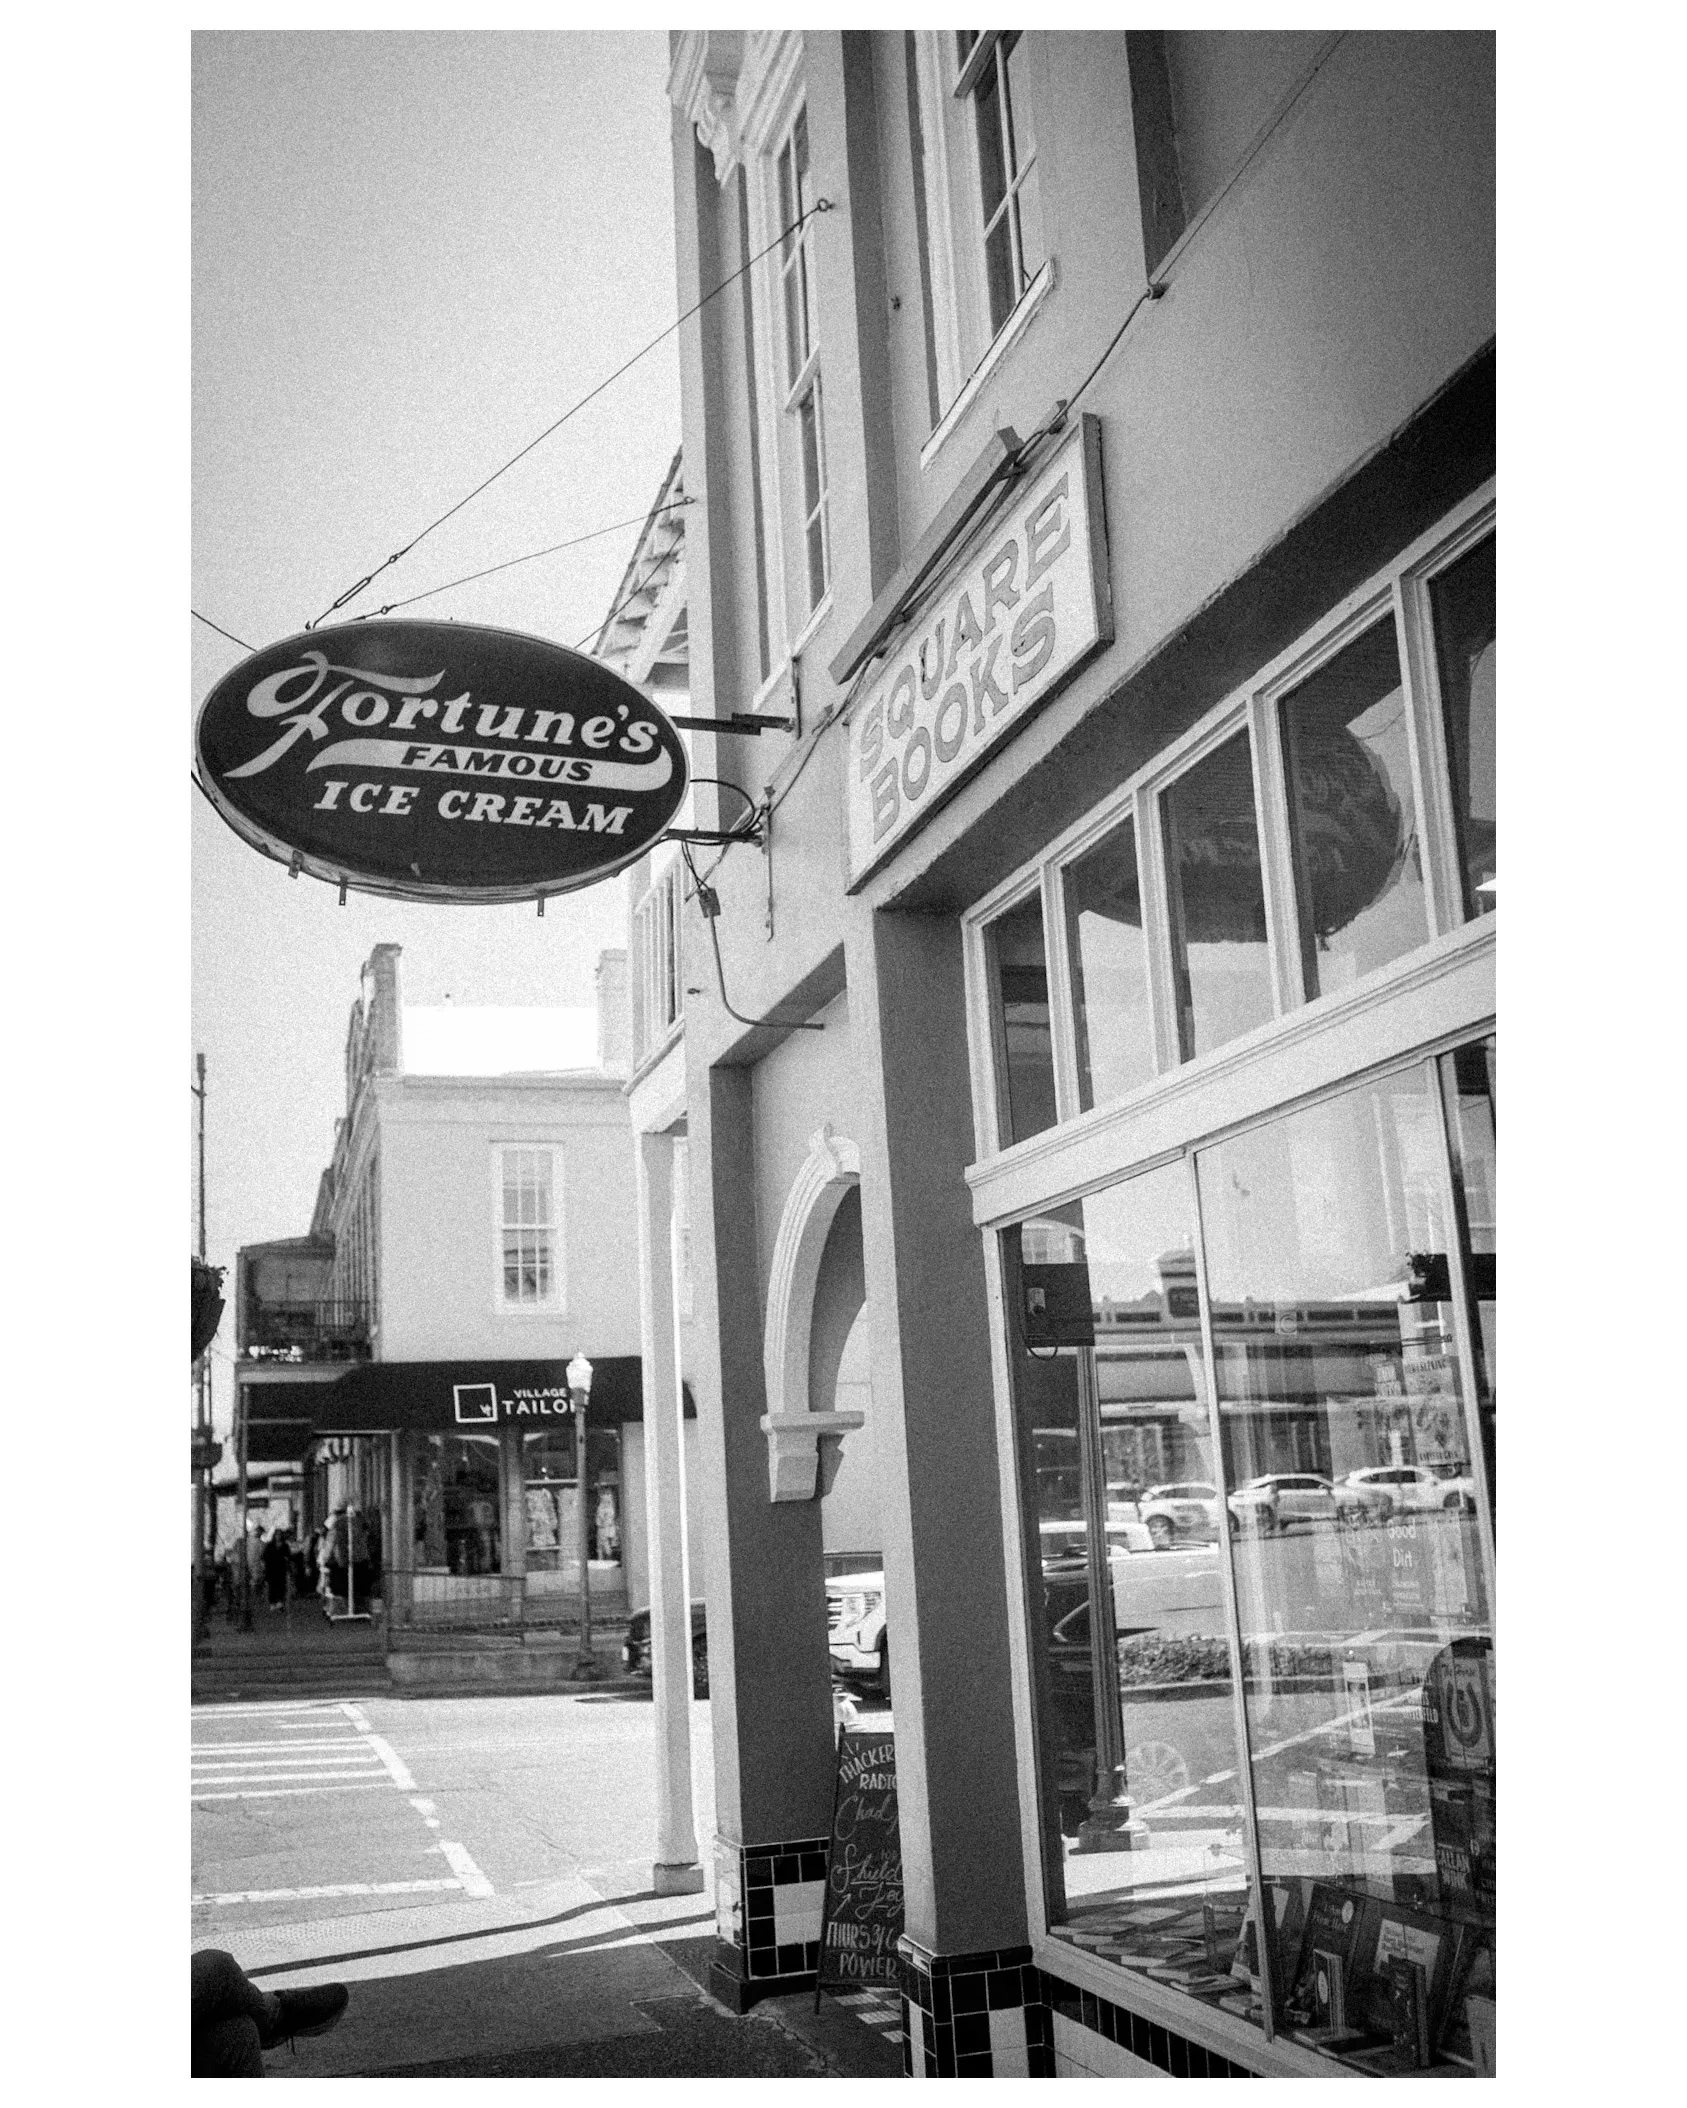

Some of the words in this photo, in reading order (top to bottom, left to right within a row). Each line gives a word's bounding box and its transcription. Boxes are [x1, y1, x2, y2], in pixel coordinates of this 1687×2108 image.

[860, 471, 1071, 782] SQUARE
[223, 651, 660, 778] Fortune's
[871, 581, 1057, 844] BOOKS
[401, 746, 594, 782] FAMOUS
[313, 780, 419, 816] ICE
[437, 789, 634, 836] CREAM
[502, 1399, 575, 1415] TAILO
[513, 1388, 567, 1399] VILLAGE
[838, 1952, 898, 1980] POWER
